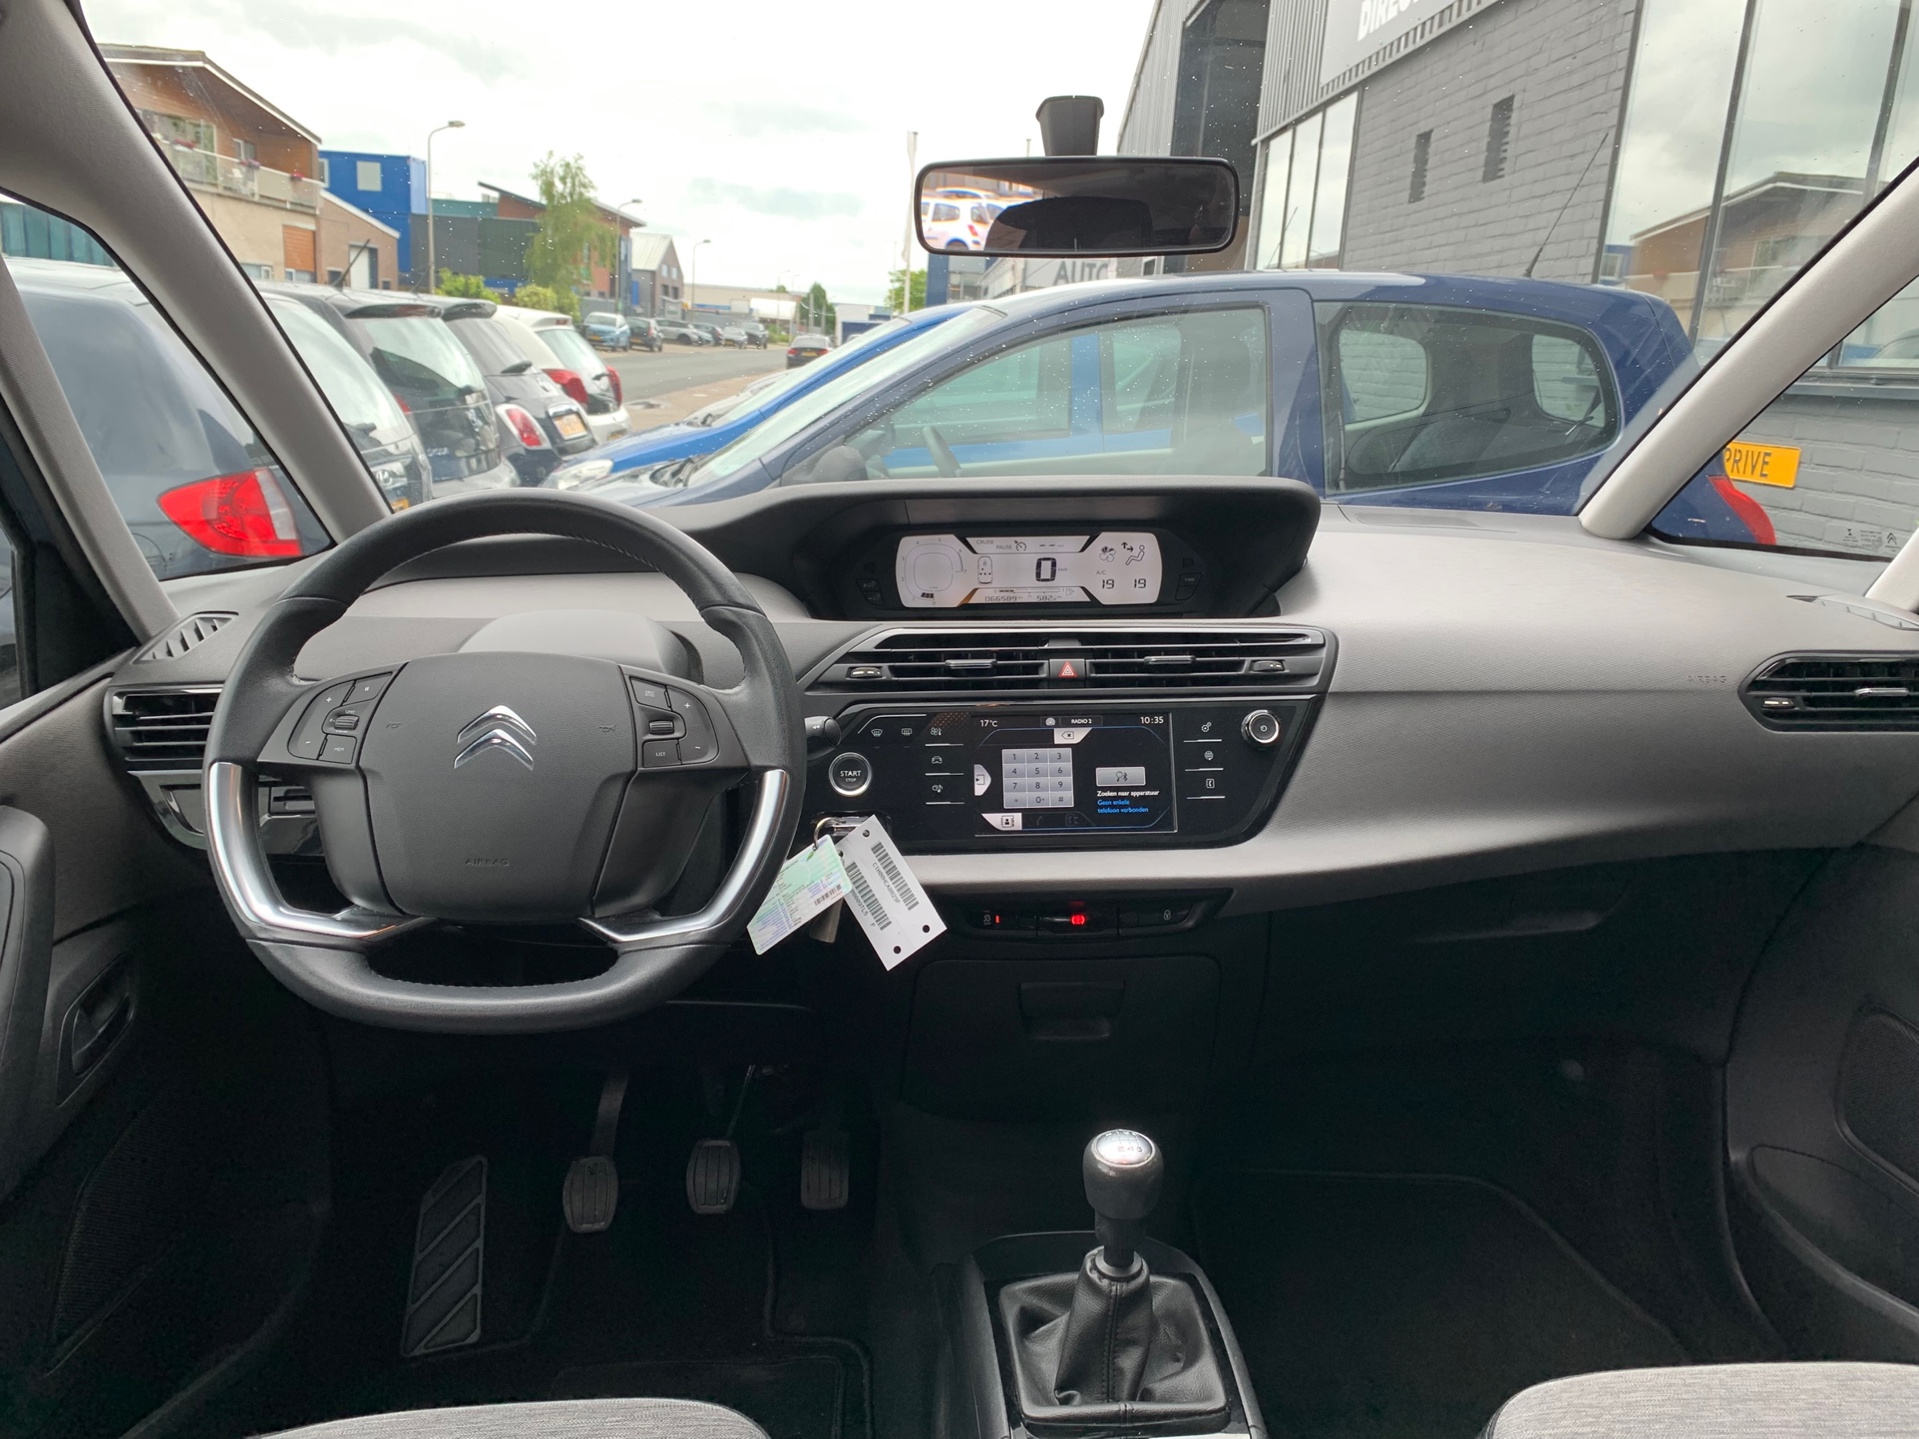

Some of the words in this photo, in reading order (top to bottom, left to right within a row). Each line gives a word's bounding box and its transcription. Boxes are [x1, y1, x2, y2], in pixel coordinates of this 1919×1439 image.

[1357, 0, 1418, 41] DIRE
[1036, 557, 1057, 582] 0
[1102, 579, 1115, 589] 19
[1134, 578, 1147, 589] 19
[1140, 716, 1164, 724] 10:35
[1034, 752, 1039, 760] 2
[1057, 752, 1061, 760] 3
[1035, 767, 1040, 775] 5
[1012, 782, 1017, 790] 7
[465, 858, 509, 867] AIRBAG
